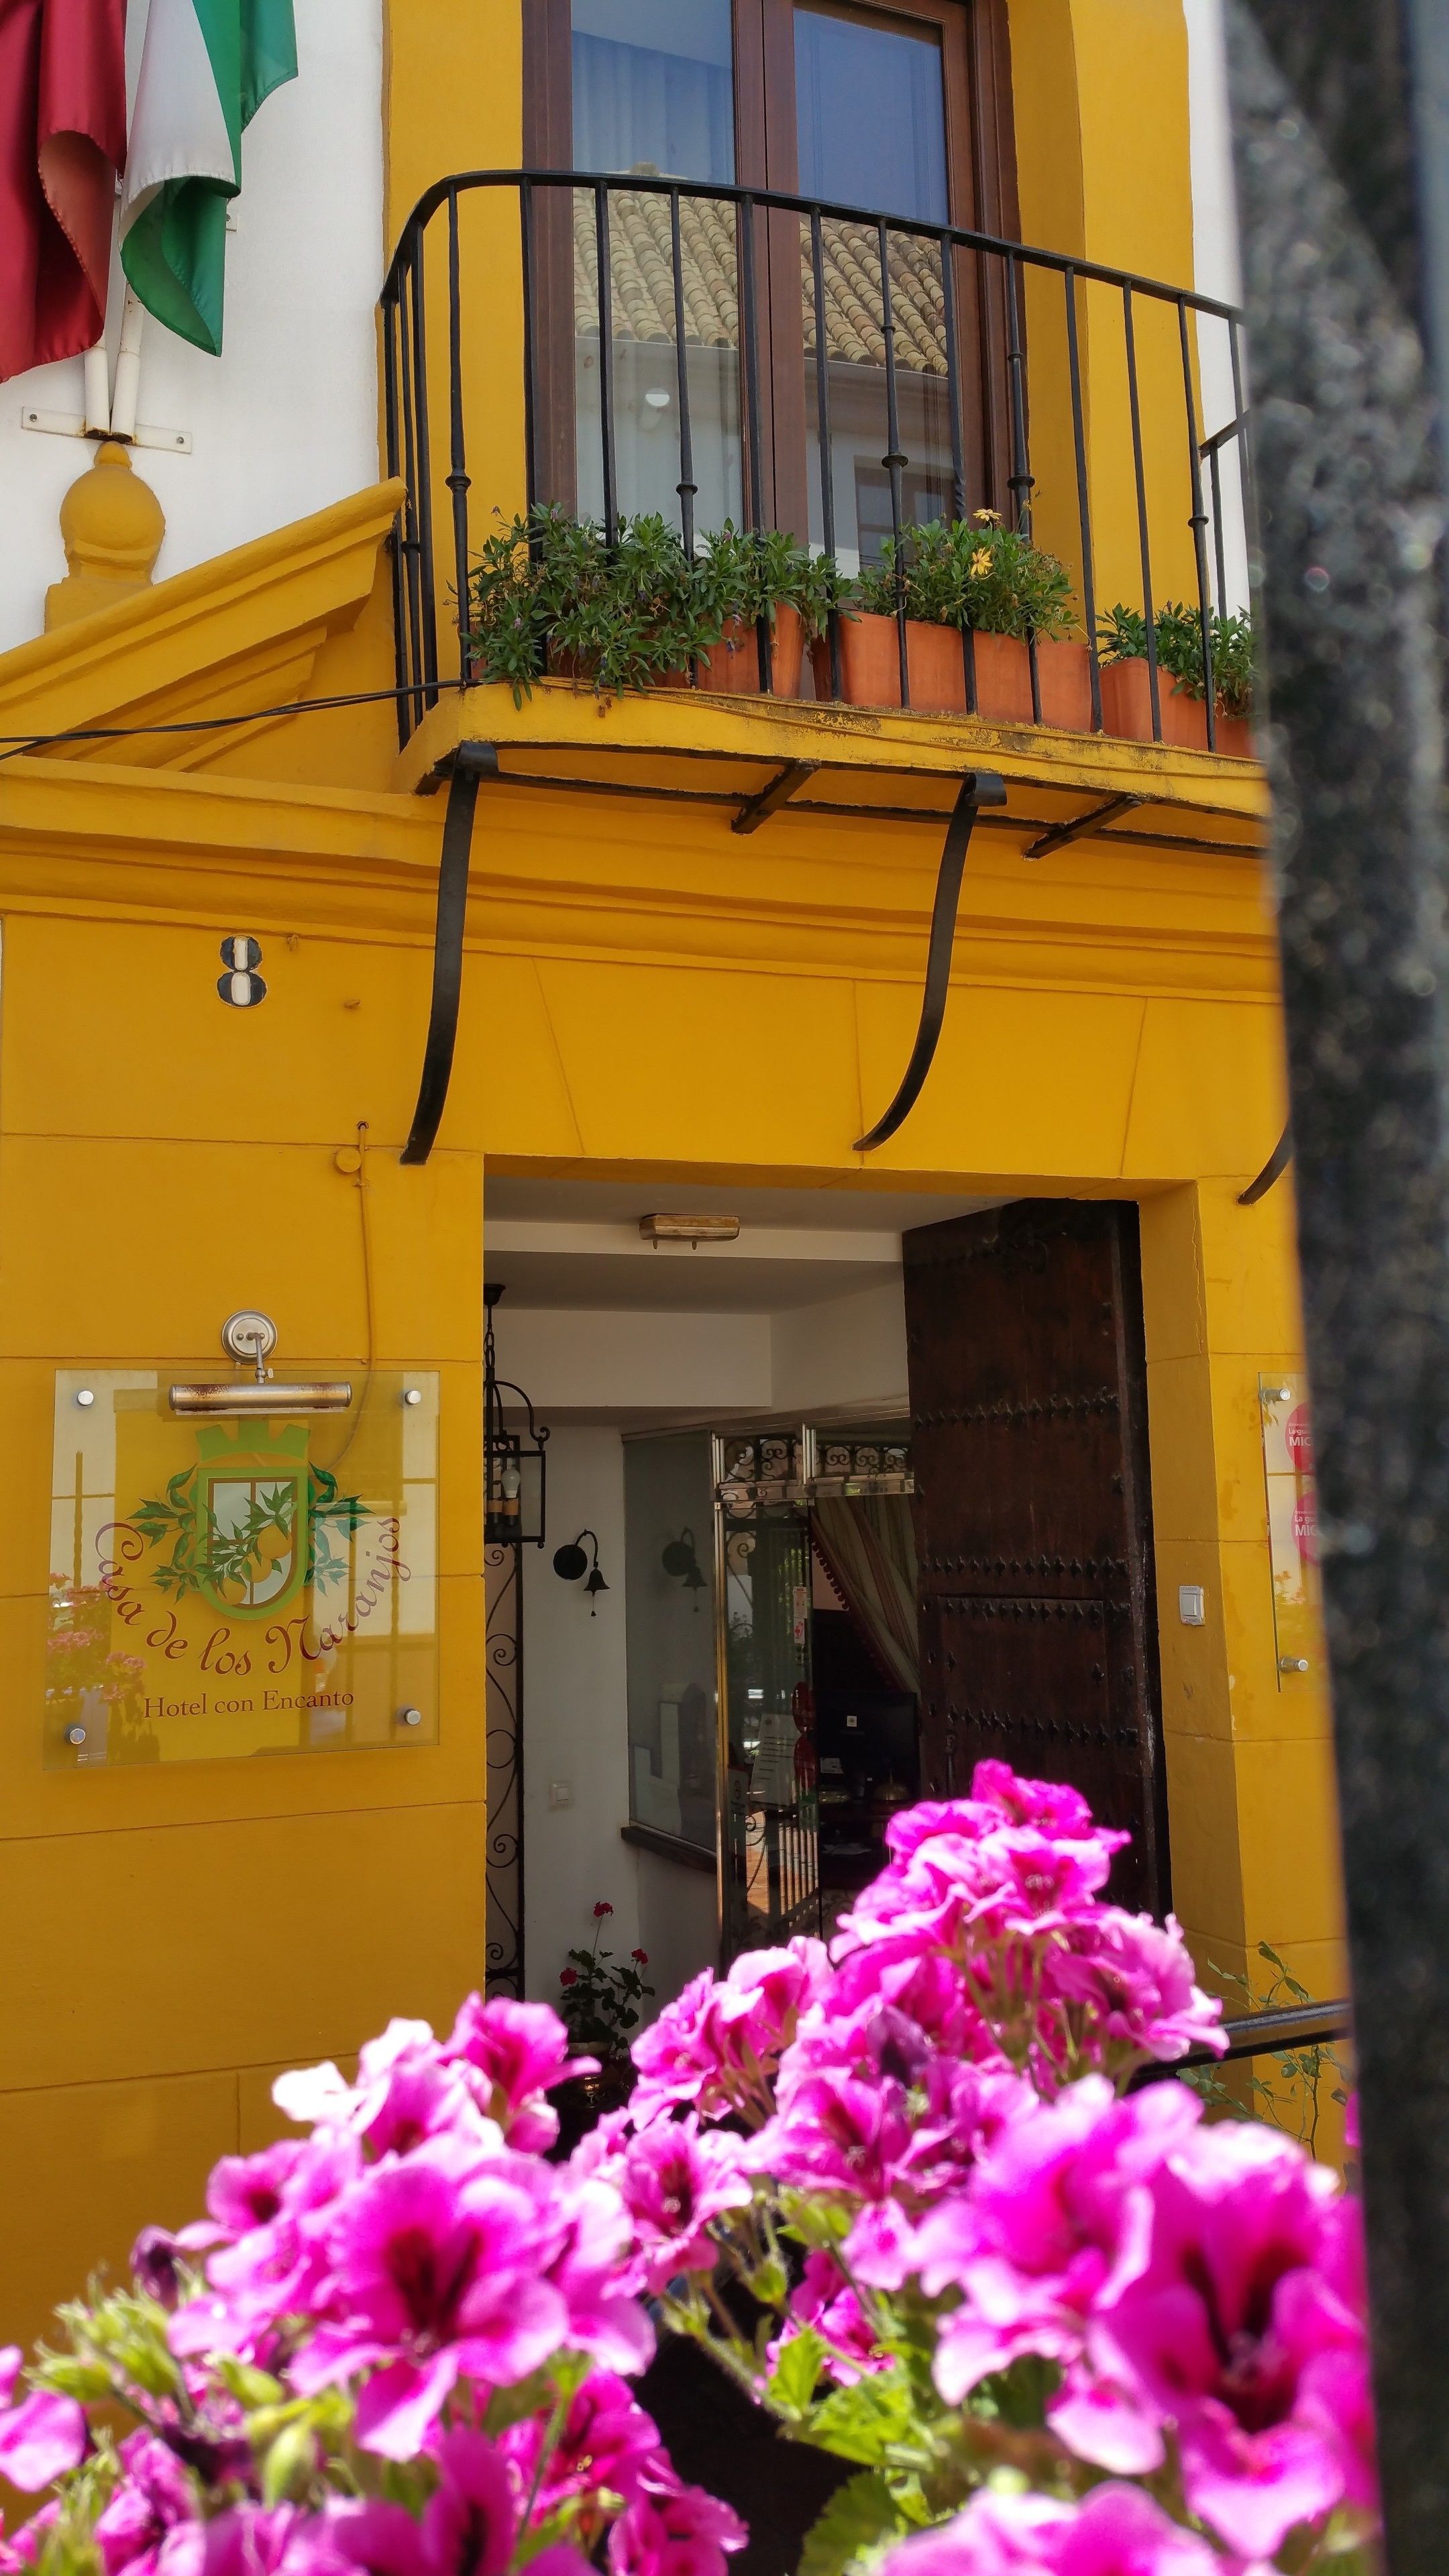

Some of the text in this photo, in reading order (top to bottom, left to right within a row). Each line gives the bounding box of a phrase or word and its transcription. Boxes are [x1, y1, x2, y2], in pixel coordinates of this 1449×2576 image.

[217, 934, 267, 1008] 8
[1289, 1436, 1311, 1446] MIC
[1295, 1524, 1319, 1536] MIC
[95, 1517, 411, 1676] Casa de los Naranjos
[144, 1690, 354, 1718] Hotel con Encanto
